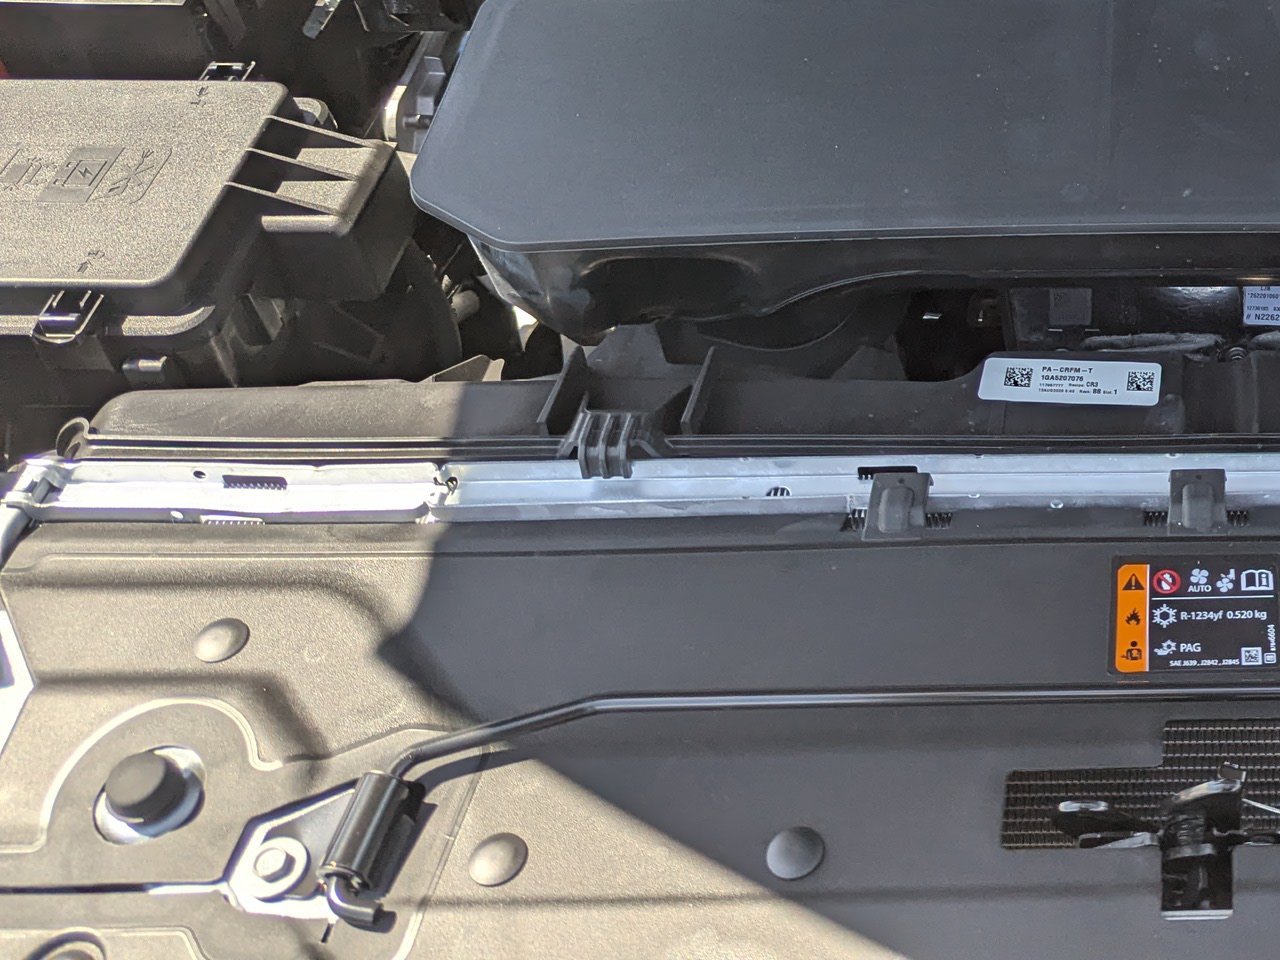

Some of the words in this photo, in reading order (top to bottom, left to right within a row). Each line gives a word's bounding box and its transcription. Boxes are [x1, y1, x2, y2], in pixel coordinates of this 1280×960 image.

[1187, 584, 1212, 593] AUTO
[1180, 610, 1224, 621] R-1234yf
[1226, 610, 1253, 619] 0.520
[1254, 609, 1267, 620] kg
[1180, 643, 1201, 652] PAG
